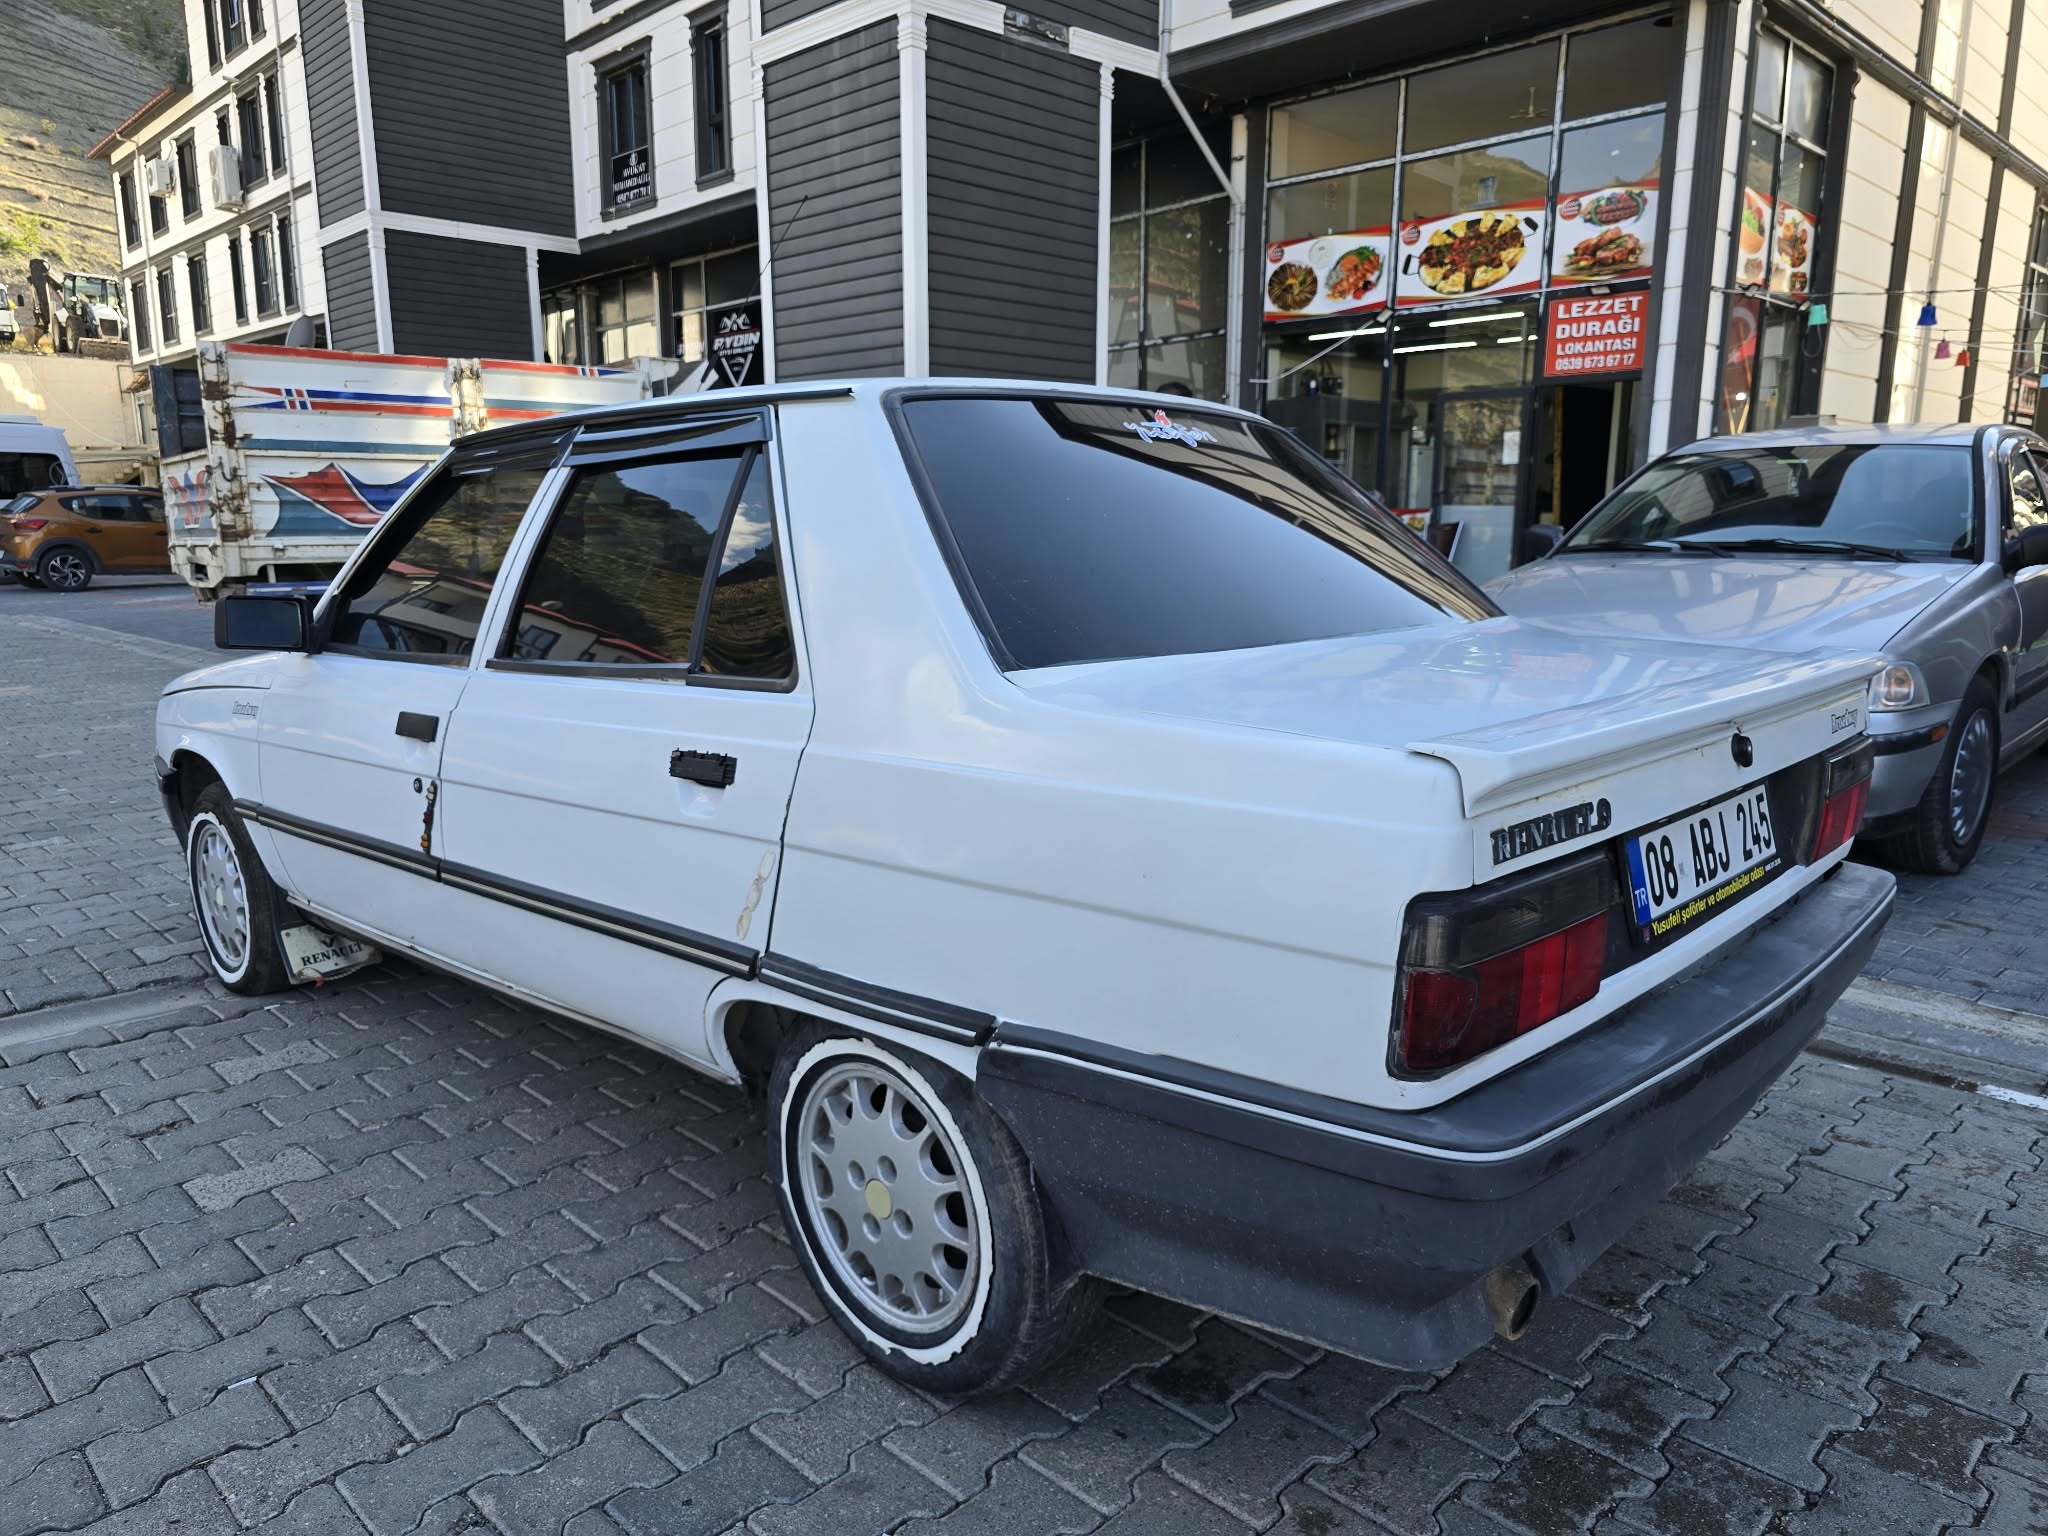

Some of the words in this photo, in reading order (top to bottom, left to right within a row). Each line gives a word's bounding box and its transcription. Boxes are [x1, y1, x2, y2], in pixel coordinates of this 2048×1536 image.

[1557, 296, 1643, 319] LEZZET
[1555, 314, 1641, 339] DURAĞI
[1556, 337, 1637, 356] LOKANTASI
[1623, 352, 1636, 366] 17
[1645, 835, 1678, 907] 08
[1689, 811, 1730, 888] ABJ
[1736, 792, 1772, 862] 245
[1634, 887, 1648, 909] TR
[1651, 910, 1681, 936] Yusufeli
[1681, 899, 1707, 924] şoförler
[1707, 895, 1716, 907] ve
[1715, 876, 1750, 902] otomobilciler
[1750, 865, 1765, 883] odası
[301, 942, 362, 967] RENAULT
